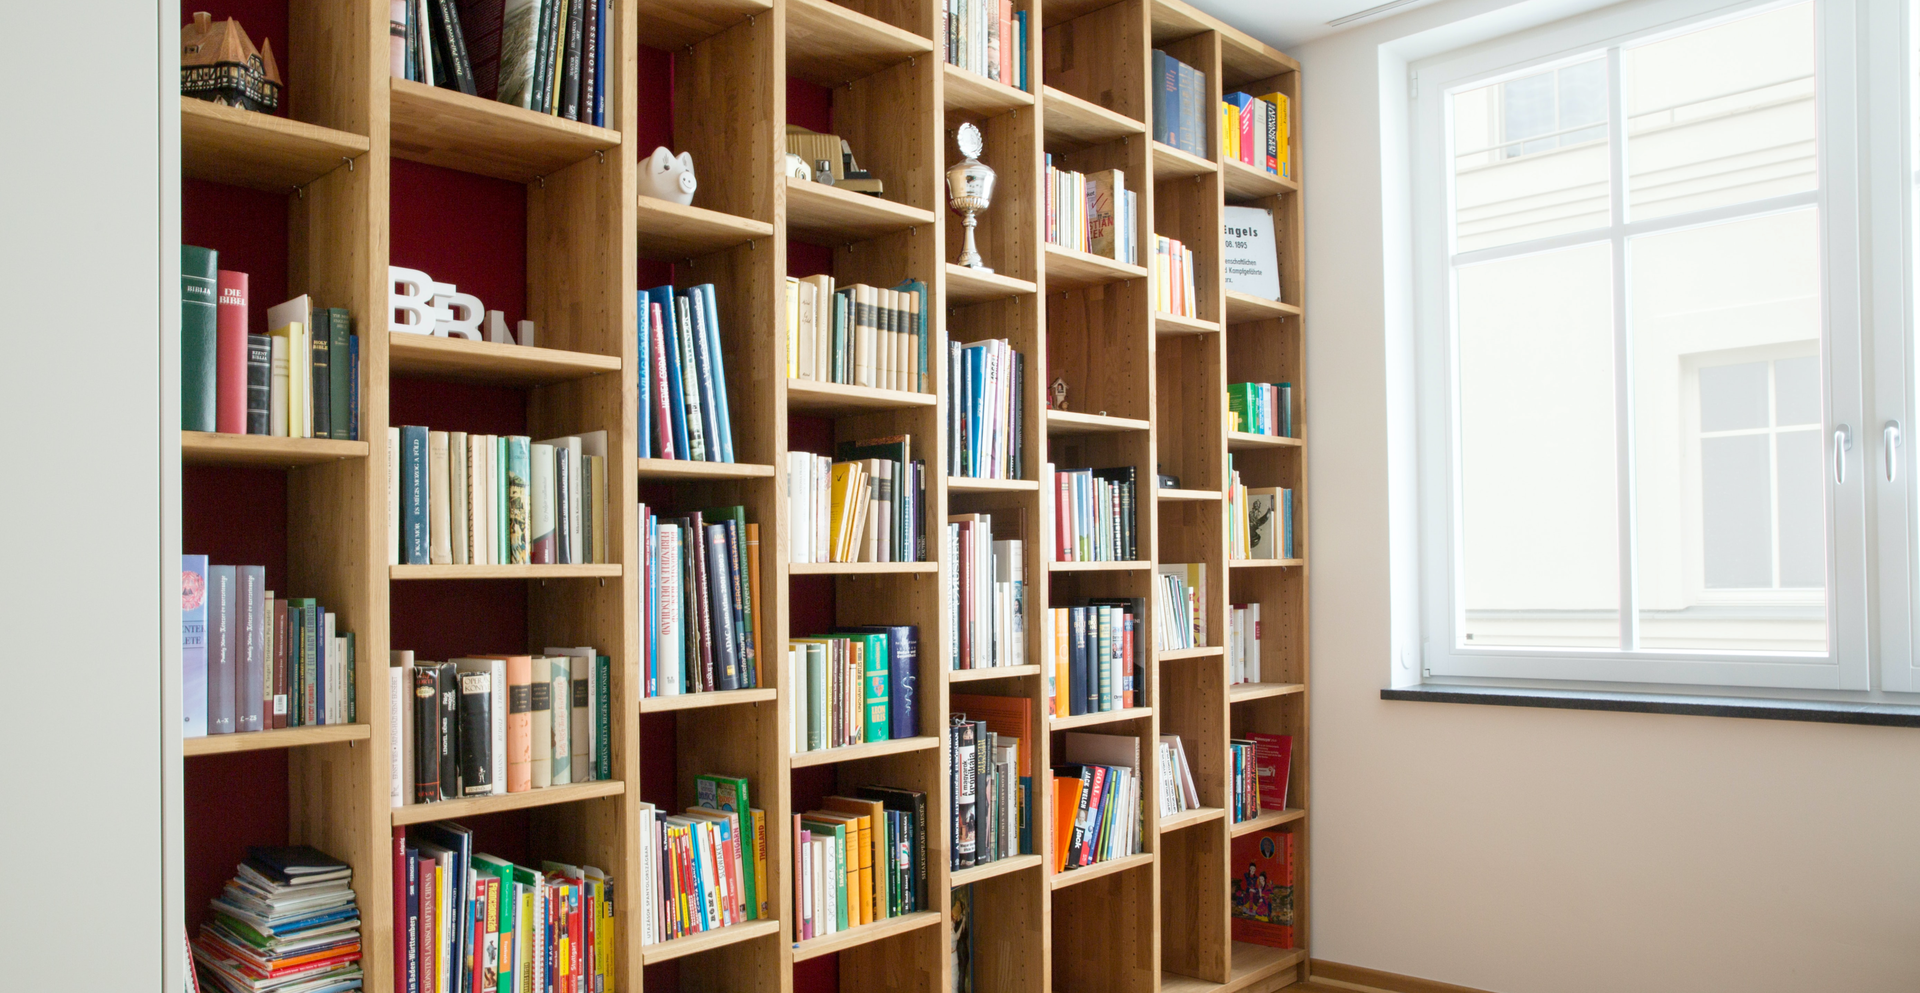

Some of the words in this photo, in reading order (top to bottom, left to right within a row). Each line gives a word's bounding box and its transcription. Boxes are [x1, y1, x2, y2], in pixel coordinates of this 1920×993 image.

[219, 296, 246, 306] BIBEL
[224, 288, 242, 298] DIE
[661, 531, 670, 575] FERIENZIELE
[730, 525, 739, 571] WELTATLAS
[740, 521, 748, 582] Universalatlas
[661, 576, 670, 585] IN
[734, 575, 742, 610] DIERCKE
[661, 585, 670, 636] DEUTSCHLAND
[742, 582, 751, 614] Meyers
[724, 630, 732, 653] ADAC
[306, 653, 315, 666] ÉLET
[872, 705, 886, 714] LEON
[1082, 771, 1091, 787] JACK
[1080, 788, 1089, 809] WELCH
[733, 827, 742, 860] UNGARN
[1075, 828, 1084, 849] jack
[424, 901, 432, 955] LANDSCHAFTEN
[408, 916, 417, 982] Baden-Württemberg
